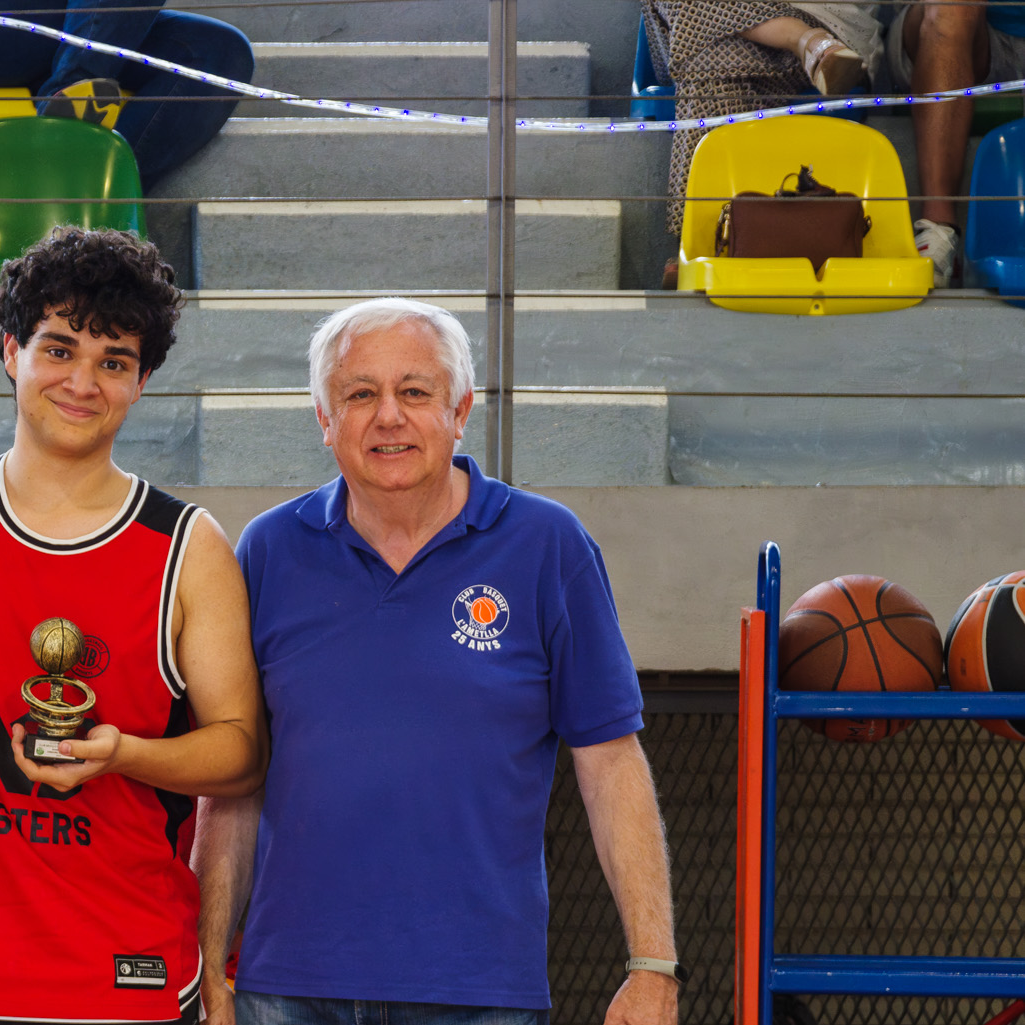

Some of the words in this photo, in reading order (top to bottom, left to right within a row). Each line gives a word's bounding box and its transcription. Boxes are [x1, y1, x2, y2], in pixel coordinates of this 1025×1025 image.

[458, 588, 474, 603] CLUB
[482, 587, 507, 612] BASQUET
[457, 618, 499, 638] L'AMETLLA
[451, 630, 467, 645] 25
[467, 639, 501, 652] ANYS
